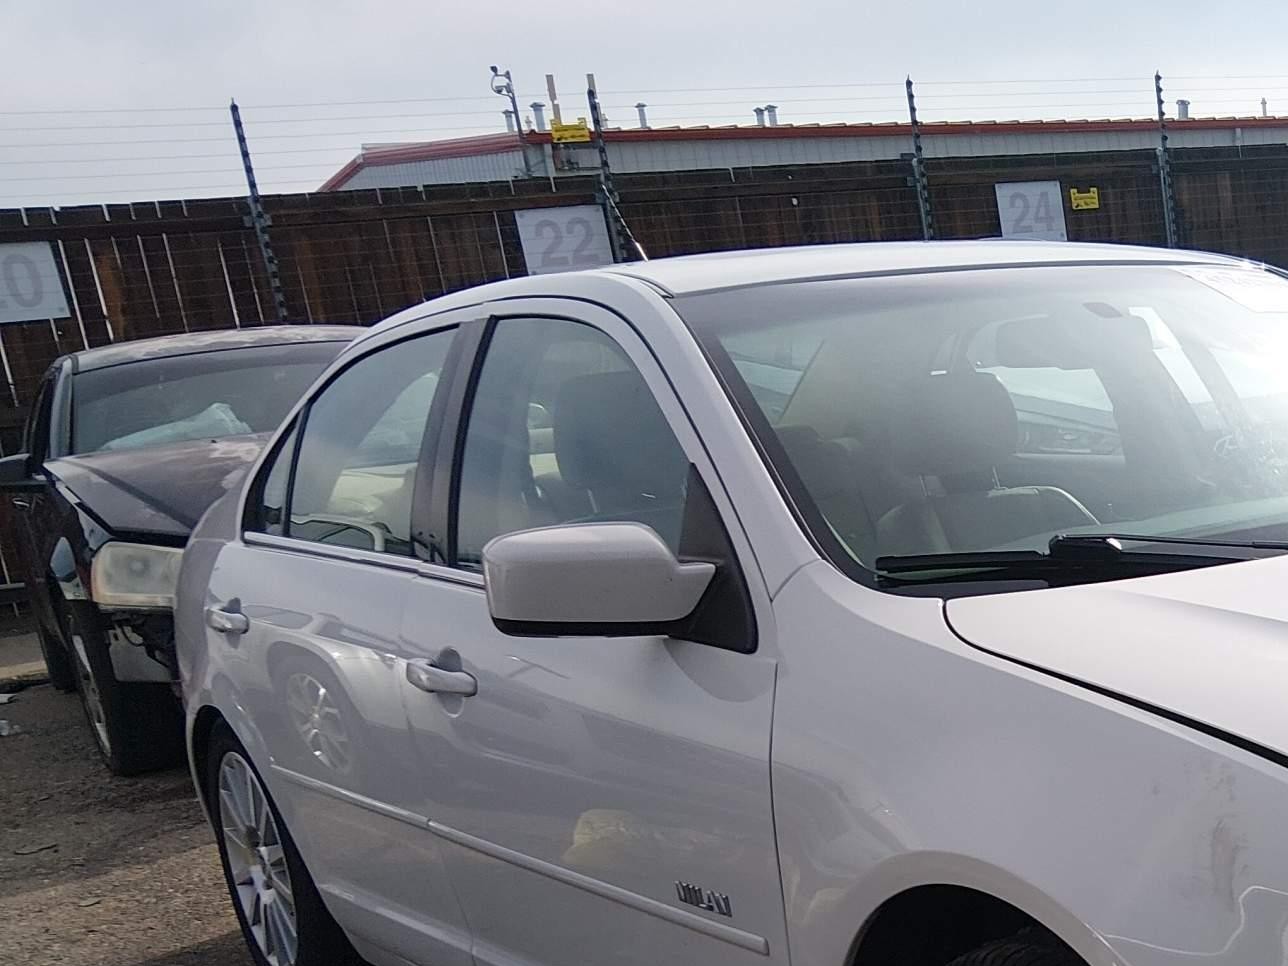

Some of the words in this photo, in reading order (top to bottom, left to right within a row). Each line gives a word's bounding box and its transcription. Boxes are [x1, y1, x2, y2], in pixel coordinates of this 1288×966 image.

[1009, 191, 1055, 233] 24
[535, 217, 603, 270] 22
[0, 253, 43, 308] 0
